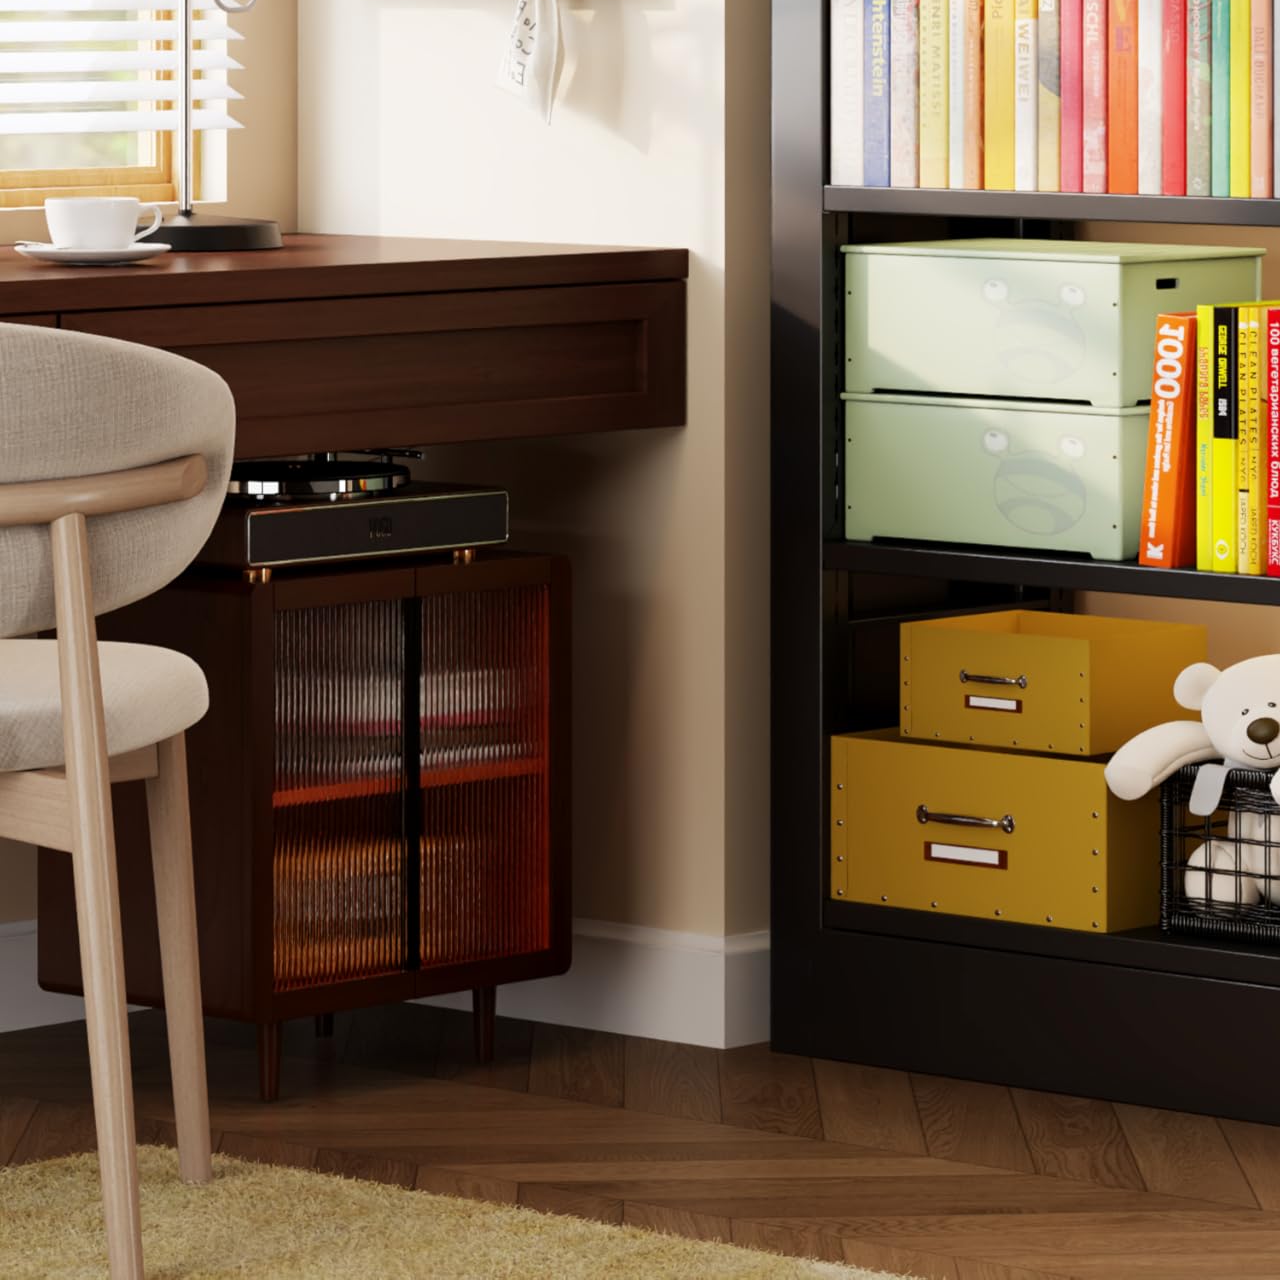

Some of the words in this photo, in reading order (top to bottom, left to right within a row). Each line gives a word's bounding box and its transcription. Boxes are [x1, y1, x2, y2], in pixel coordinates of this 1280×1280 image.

[1250, 330, 1258, 380] CLEAN
[1270, 321, 1280, 345] 100
[1154, 323, 1185, 400] 1000
[1250, 387, 1258, 444] PLATES
[1269, 348, 1280, 458] вегетарианских
[1271, 520, 1279, 565] КУКБУКС
